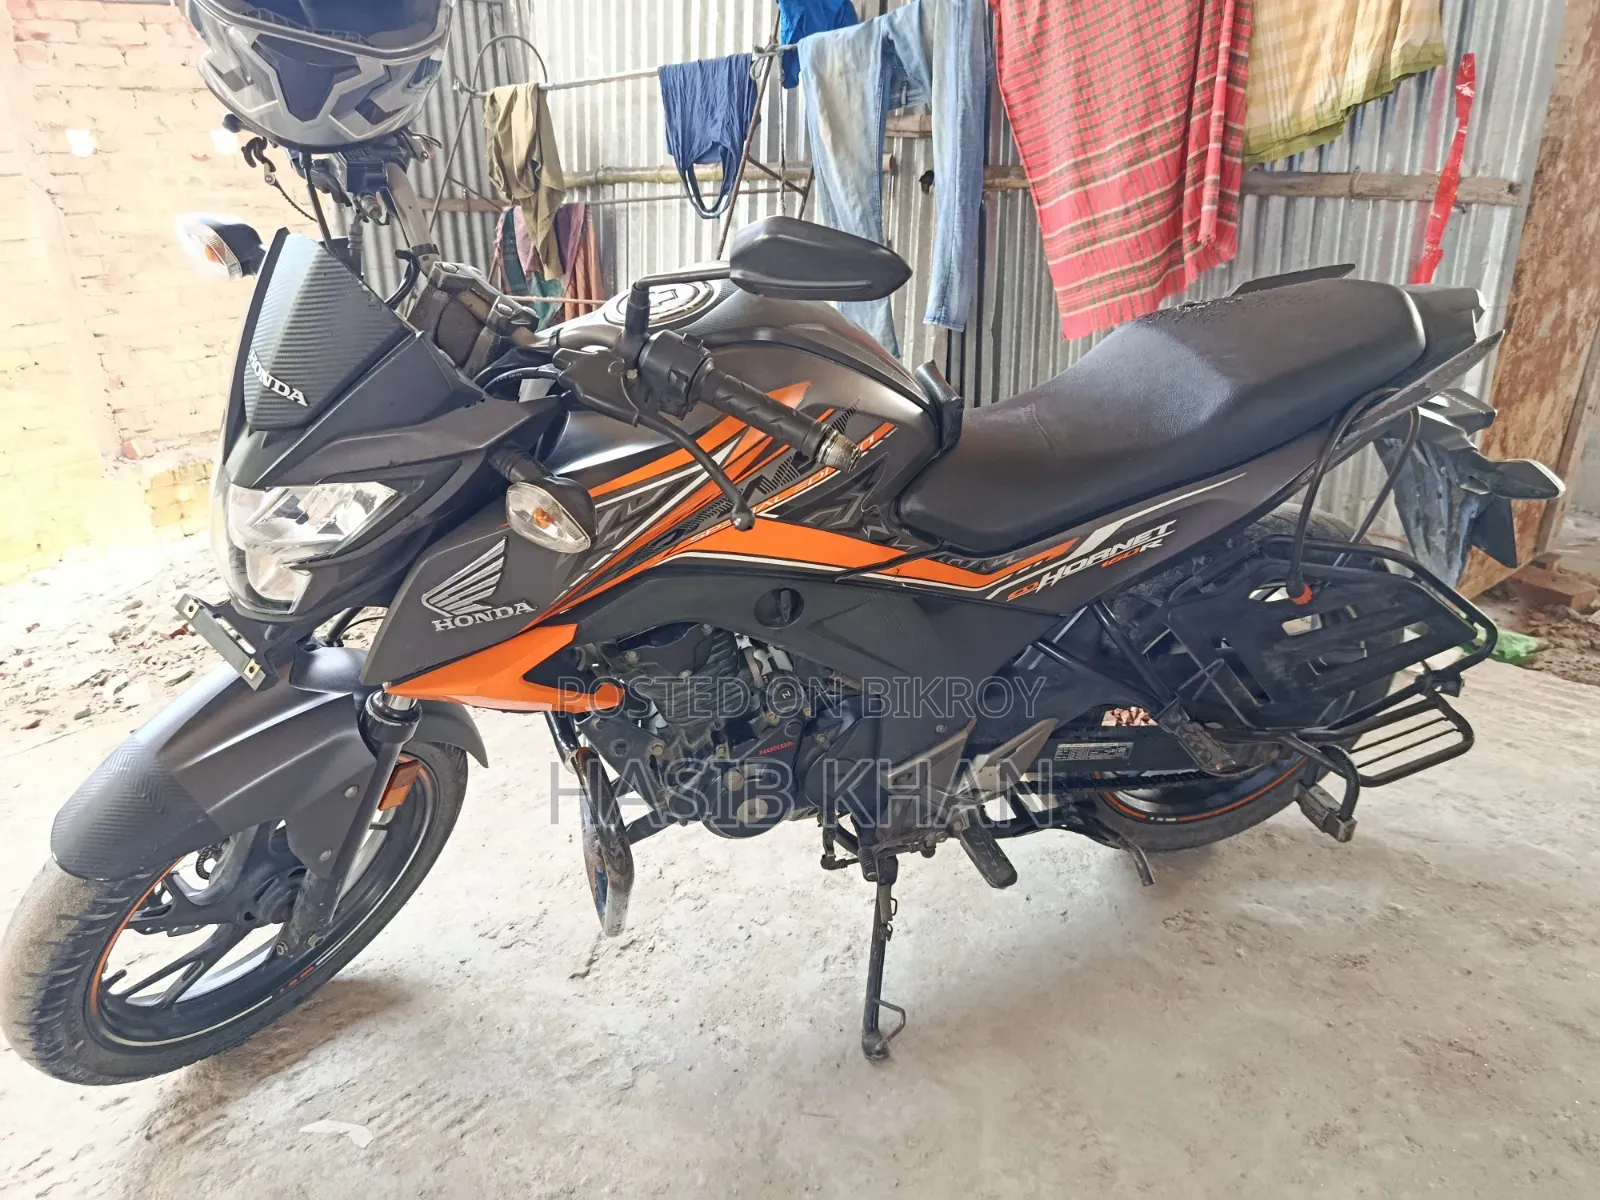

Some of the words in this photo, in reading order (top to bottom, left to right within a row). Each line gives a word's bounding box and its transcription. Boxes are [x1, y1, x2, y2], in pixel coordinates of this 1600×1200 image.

[248, 349, 308, 406] HONDA
[1035, 519, 1177, 594] HORNET
[431, 601, 537, 632] HONDA
[758, 741, 794, 756] HONDA
